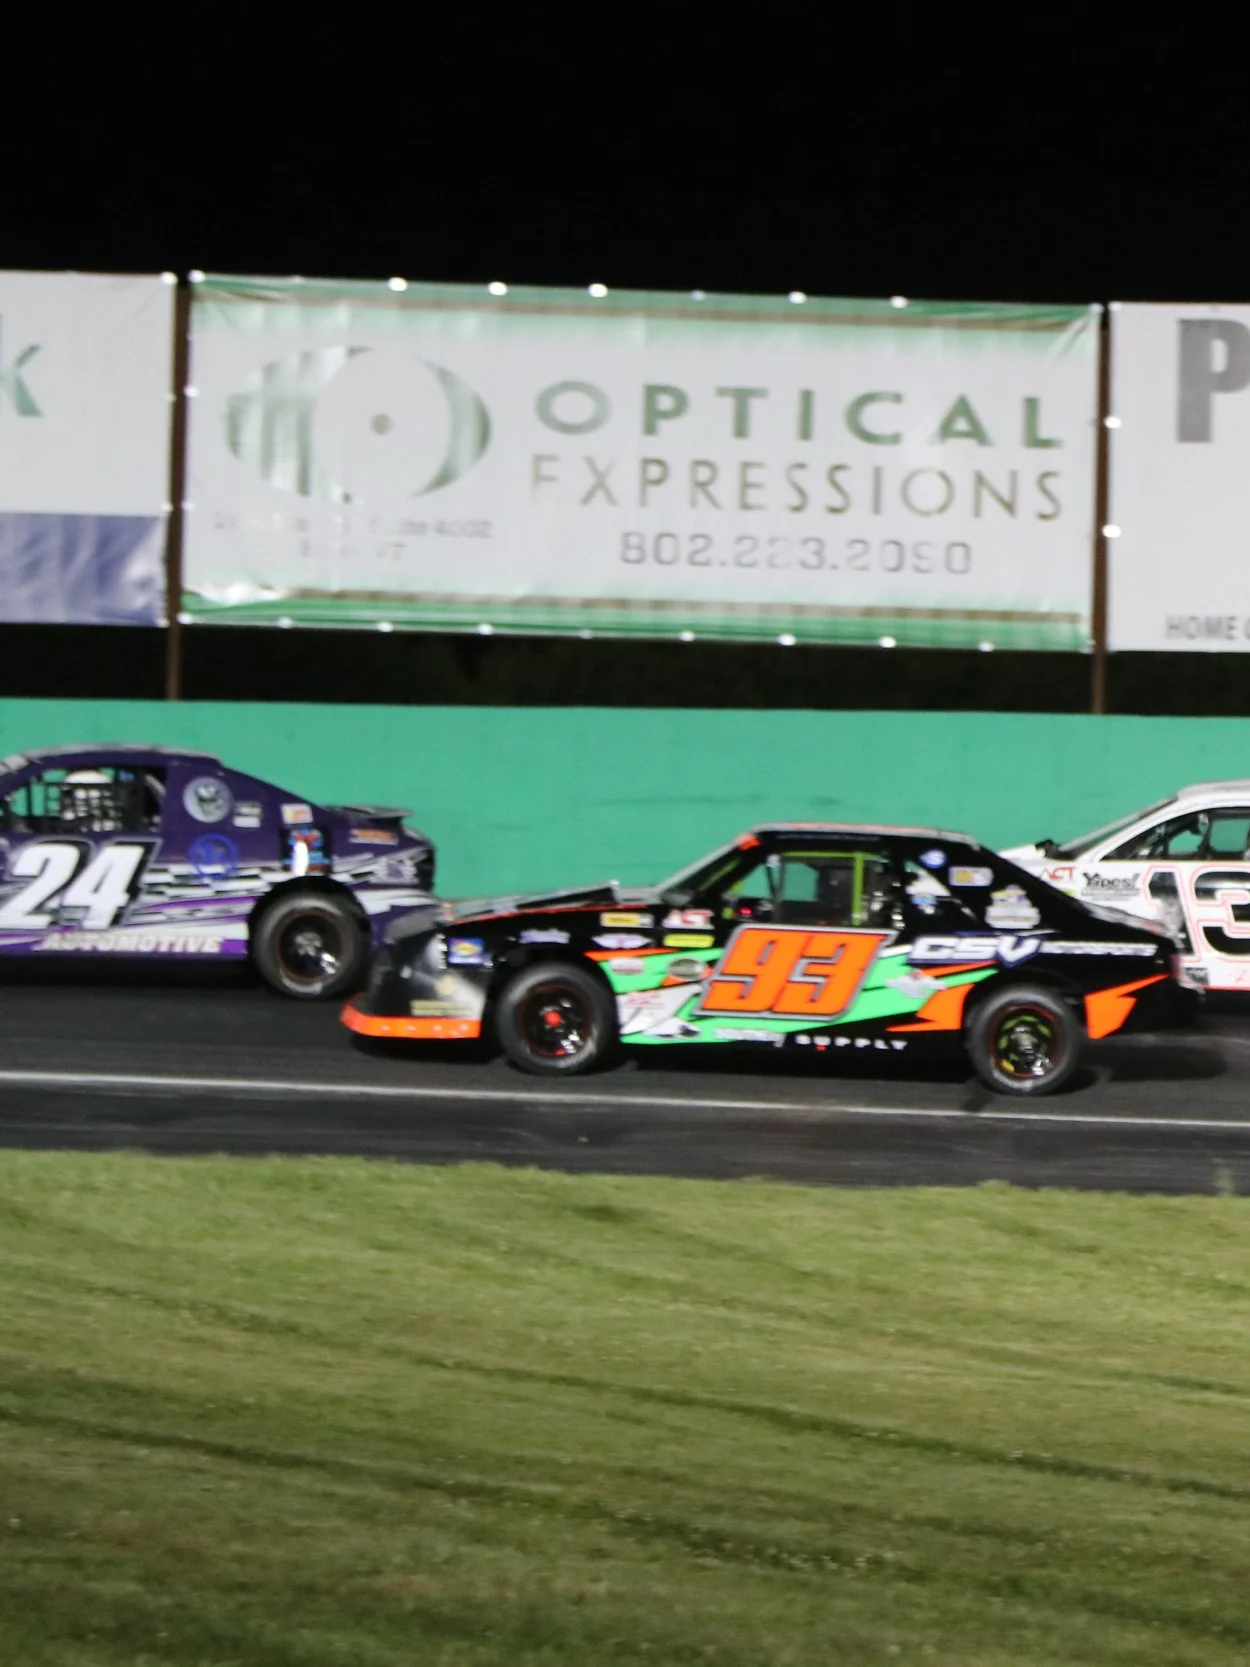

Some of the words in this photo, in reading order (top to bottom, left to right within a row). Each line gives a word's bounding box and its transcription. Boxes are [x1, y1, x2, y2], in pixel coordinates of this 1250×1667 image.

[534, 380, 1064, 450] OPTICAL
[1165, 615, 1238, 641] HOME
[0, 842, 149, 930] 24
[33, 931, 222, 954] AUTOMOTIVE
[908, 935, 1042, 966] CSV
[699, 926, 891, 1020] 93
